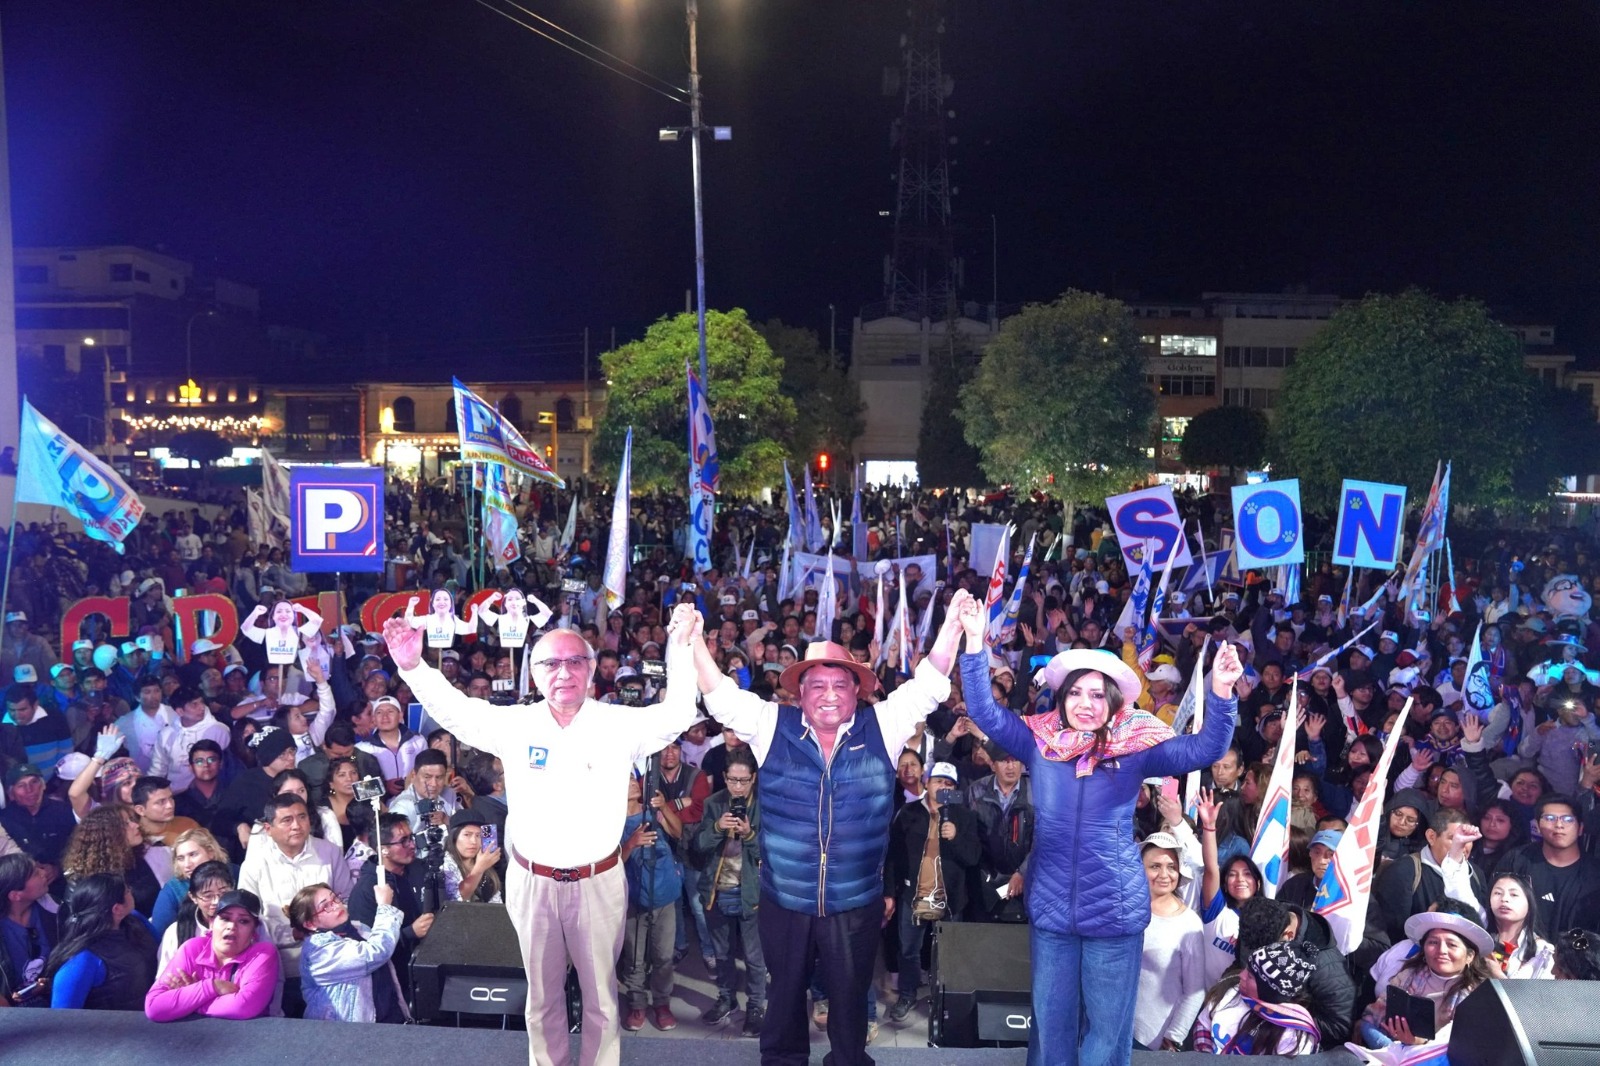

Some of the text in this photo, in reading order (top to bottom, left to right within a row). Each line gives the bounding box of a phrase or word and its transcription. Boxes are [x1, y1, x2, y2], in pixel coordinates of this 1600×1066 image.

[305, 488, 369, 550] P
[1115, 497, 1185, 565] S
[1238, 489, 1300, 560] O
[1337, 488, 1403, 563] N
